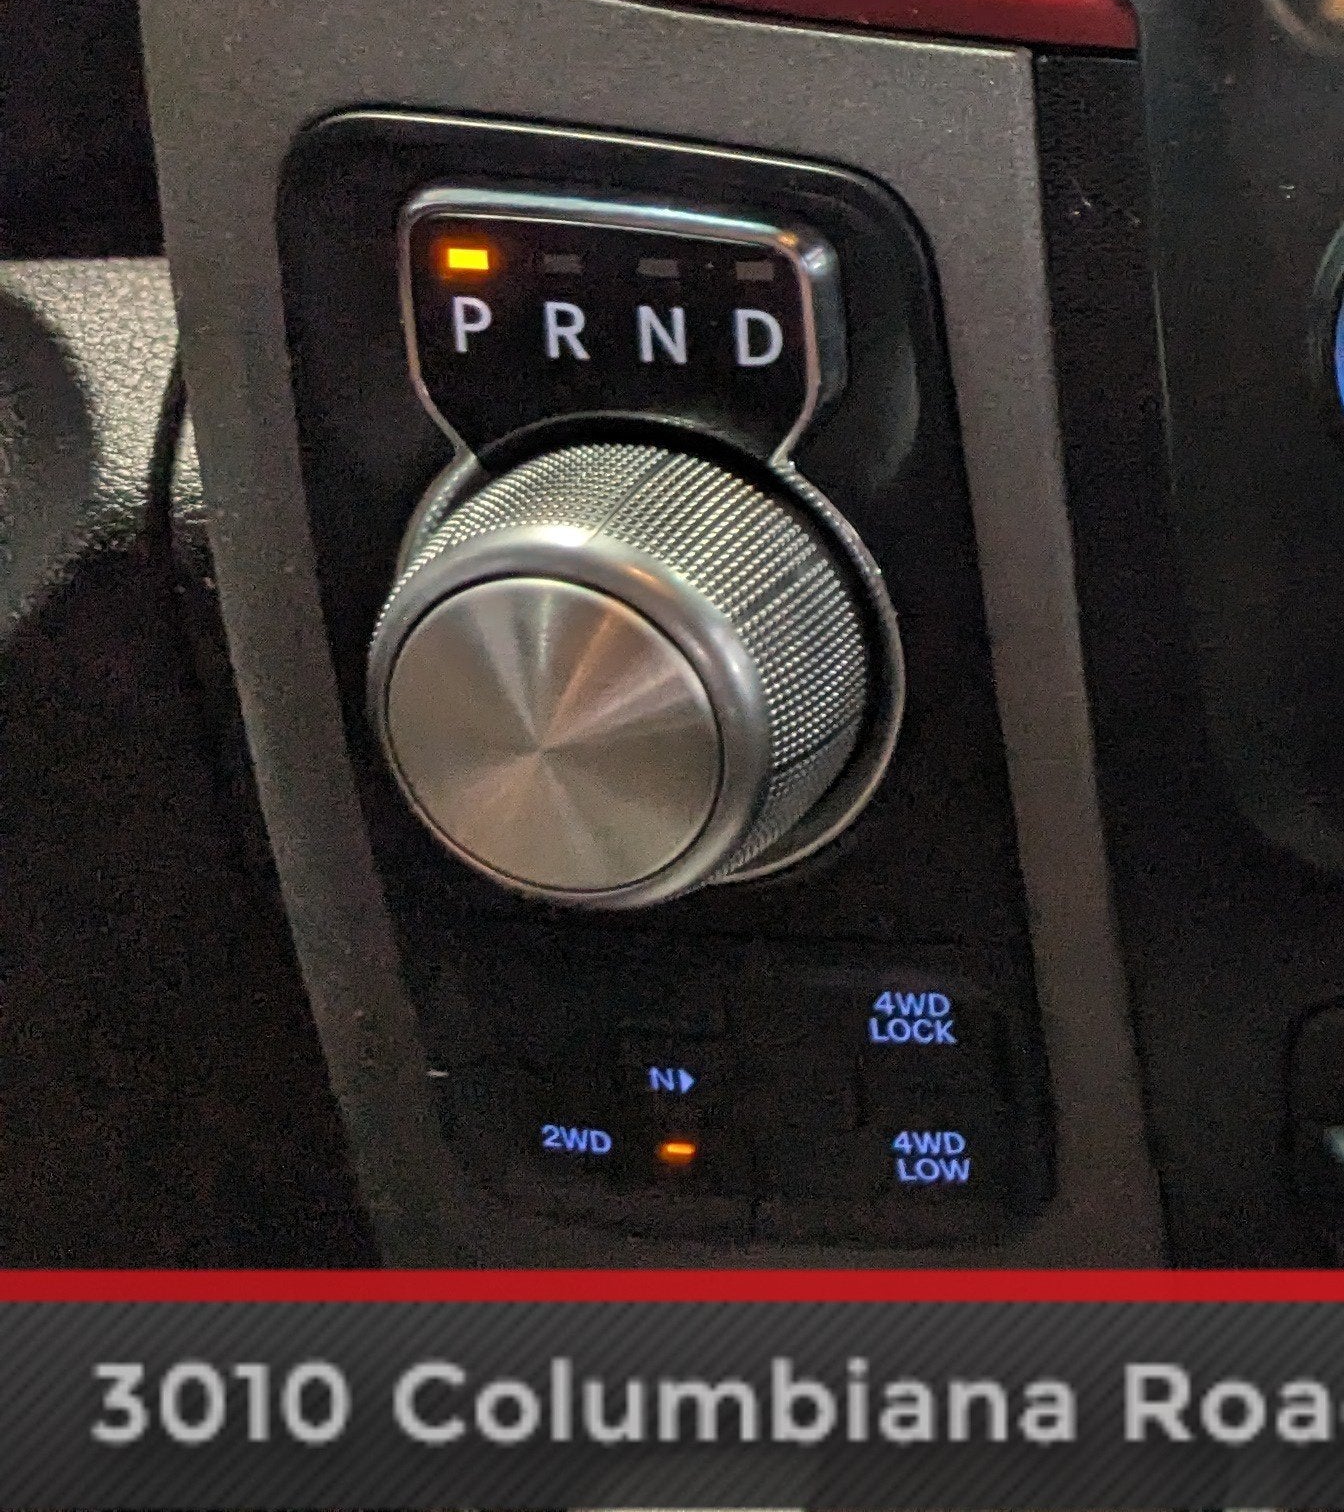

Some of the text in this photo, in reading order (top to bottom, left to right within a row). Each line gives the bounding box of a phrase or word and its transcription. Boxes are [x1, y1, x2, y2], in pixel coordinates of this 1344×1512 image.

[453, 297, 783, 366] P R N D
[873, 992, 950, 1016] 4WD
[870, 1019, 956, 1044] LOCK
[649, 1068, 673, 1090] N
[541, 1124, 612, 1152] 2WD
[893, 1132, 966, 1155] 4WD
[897, 1159, 971, 1182] LOW
